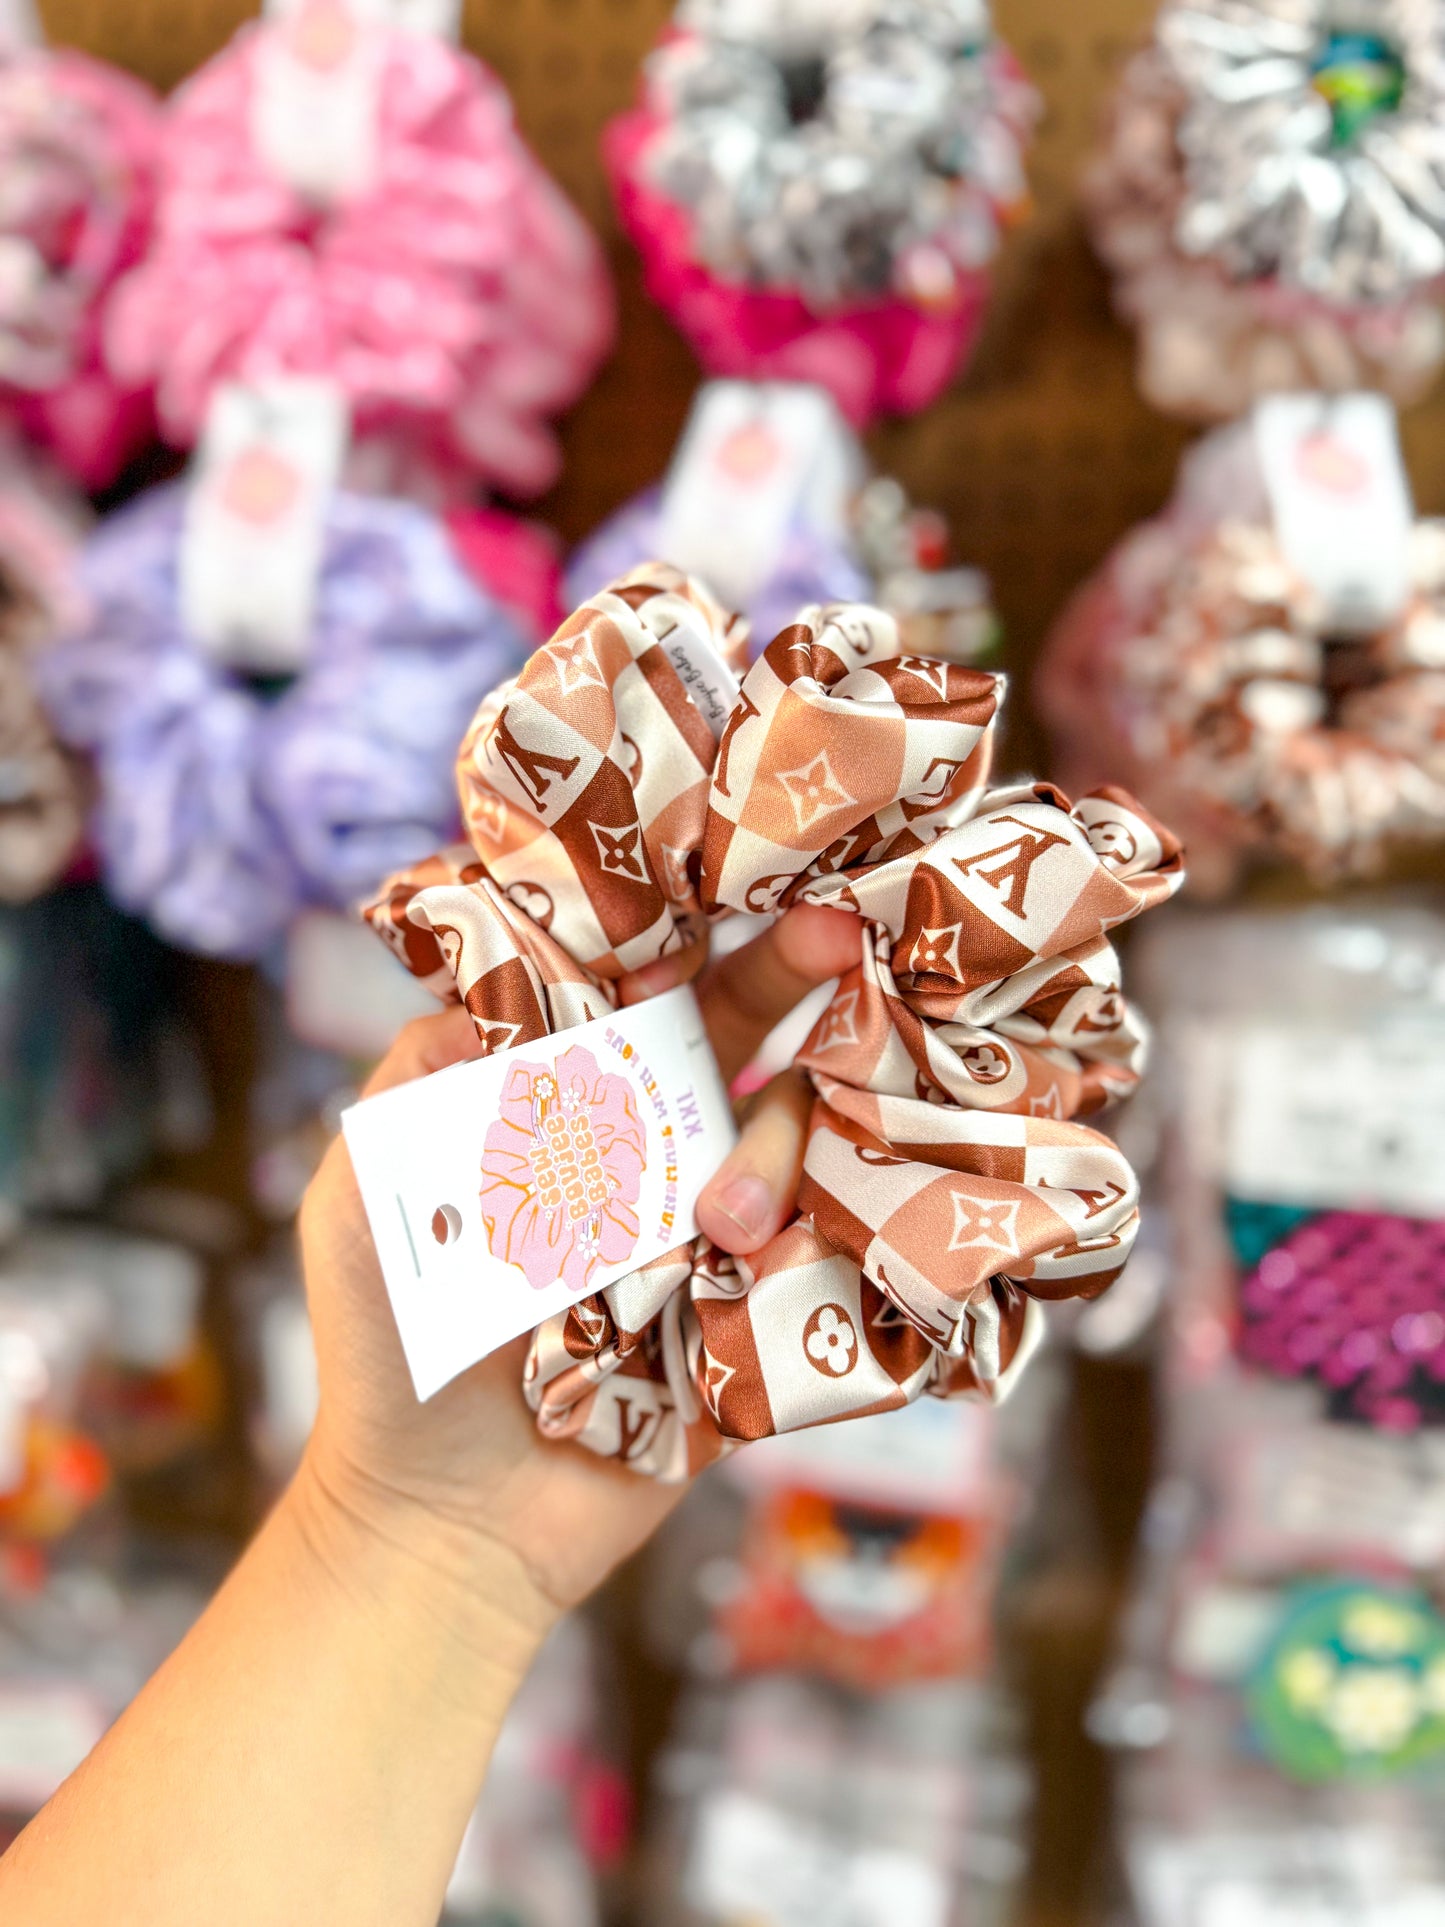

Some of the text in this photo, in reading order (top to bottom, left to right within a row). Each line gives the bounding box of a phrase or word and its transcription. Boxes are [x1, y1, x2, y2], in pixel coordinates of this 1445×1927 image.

[569, 1114, 609, 1206] Babes
[604, 1027, 679, 1244] HANDMADE WITH LOVE
[676, 1088, 704, 1139] XXL
[545, 1114, 591, 1222] Boujee
